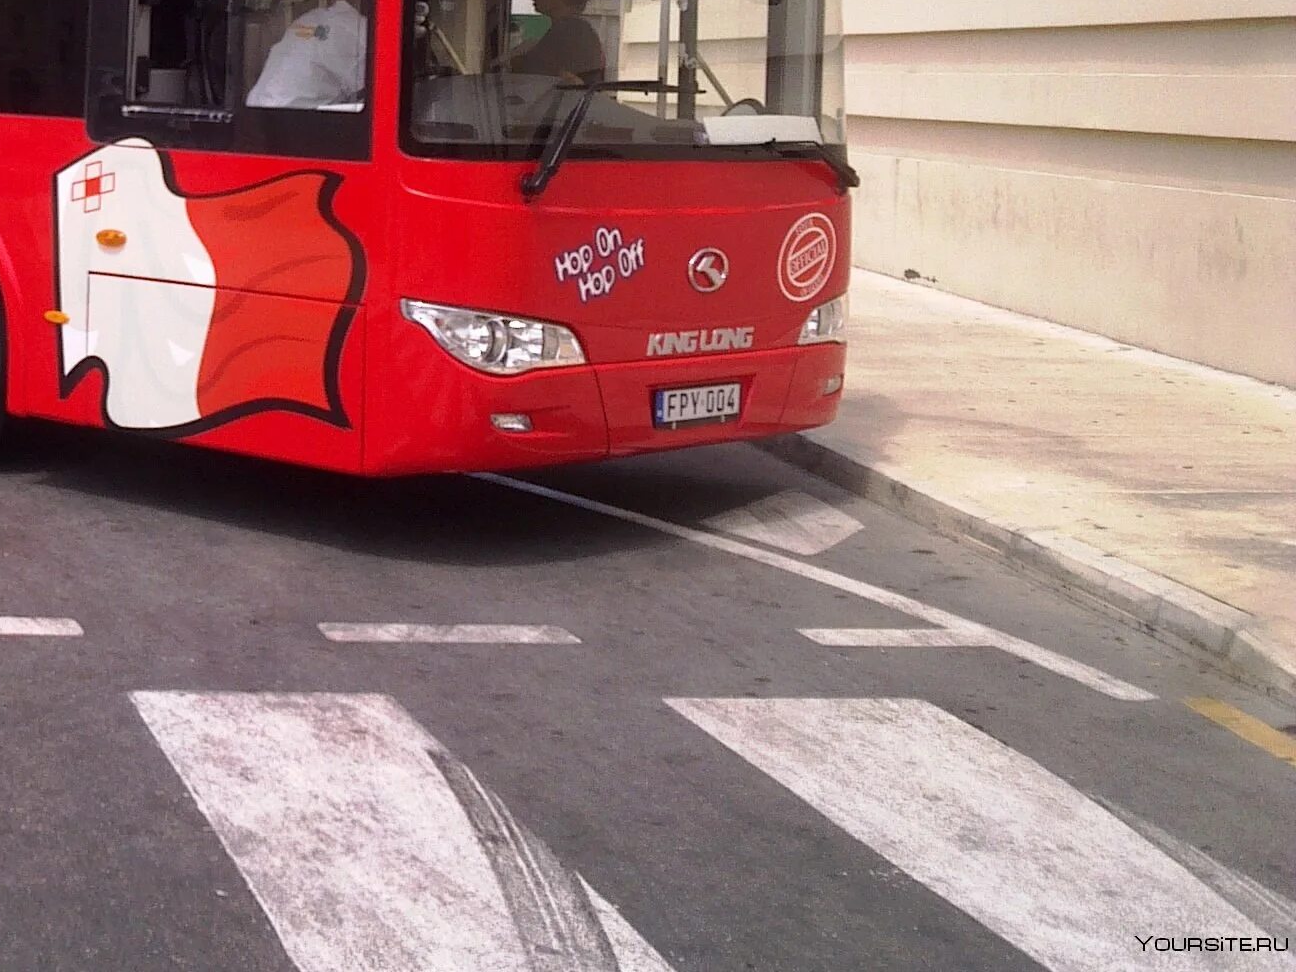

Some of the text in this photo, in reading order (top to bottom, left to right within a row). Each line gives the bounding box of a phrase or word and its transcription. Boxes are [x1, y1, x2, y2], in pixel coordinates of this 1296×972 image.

[646, 326, 755, 357] KING LONG
[668, 387, 735, 418] FPY 004
